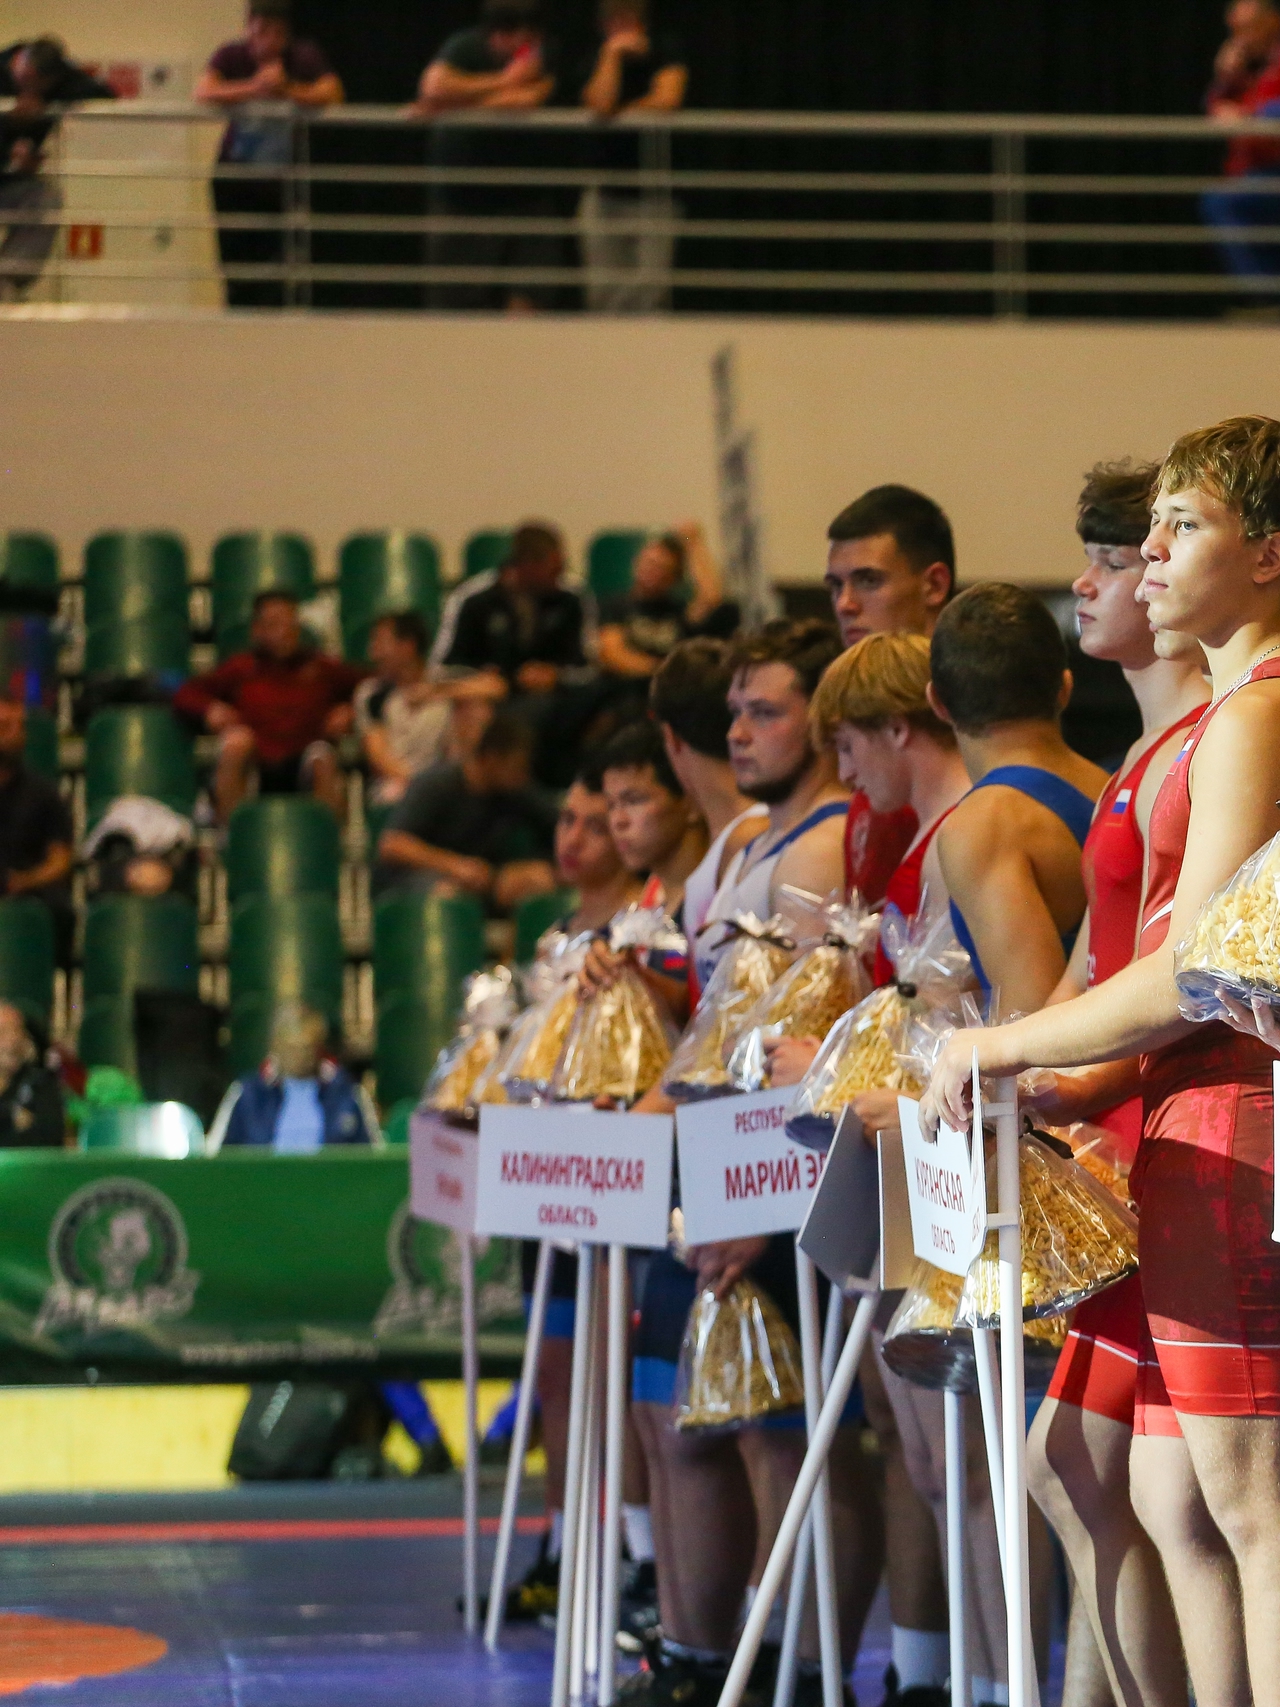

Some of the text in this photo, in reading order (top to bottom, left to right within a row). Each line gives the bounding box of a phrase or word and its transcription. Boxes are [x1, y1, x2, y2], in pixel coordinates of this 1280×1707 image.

[501, 1152, 644, 1194] КАЛИНИНГРАДСКАЯ
[725, 1149, 800, 1200] МАРИЙ
[538, 1203, 598, 1228] ОБЛАСТЬ
[931, 1222, 956, 1255] ОБЛАСТЬ
